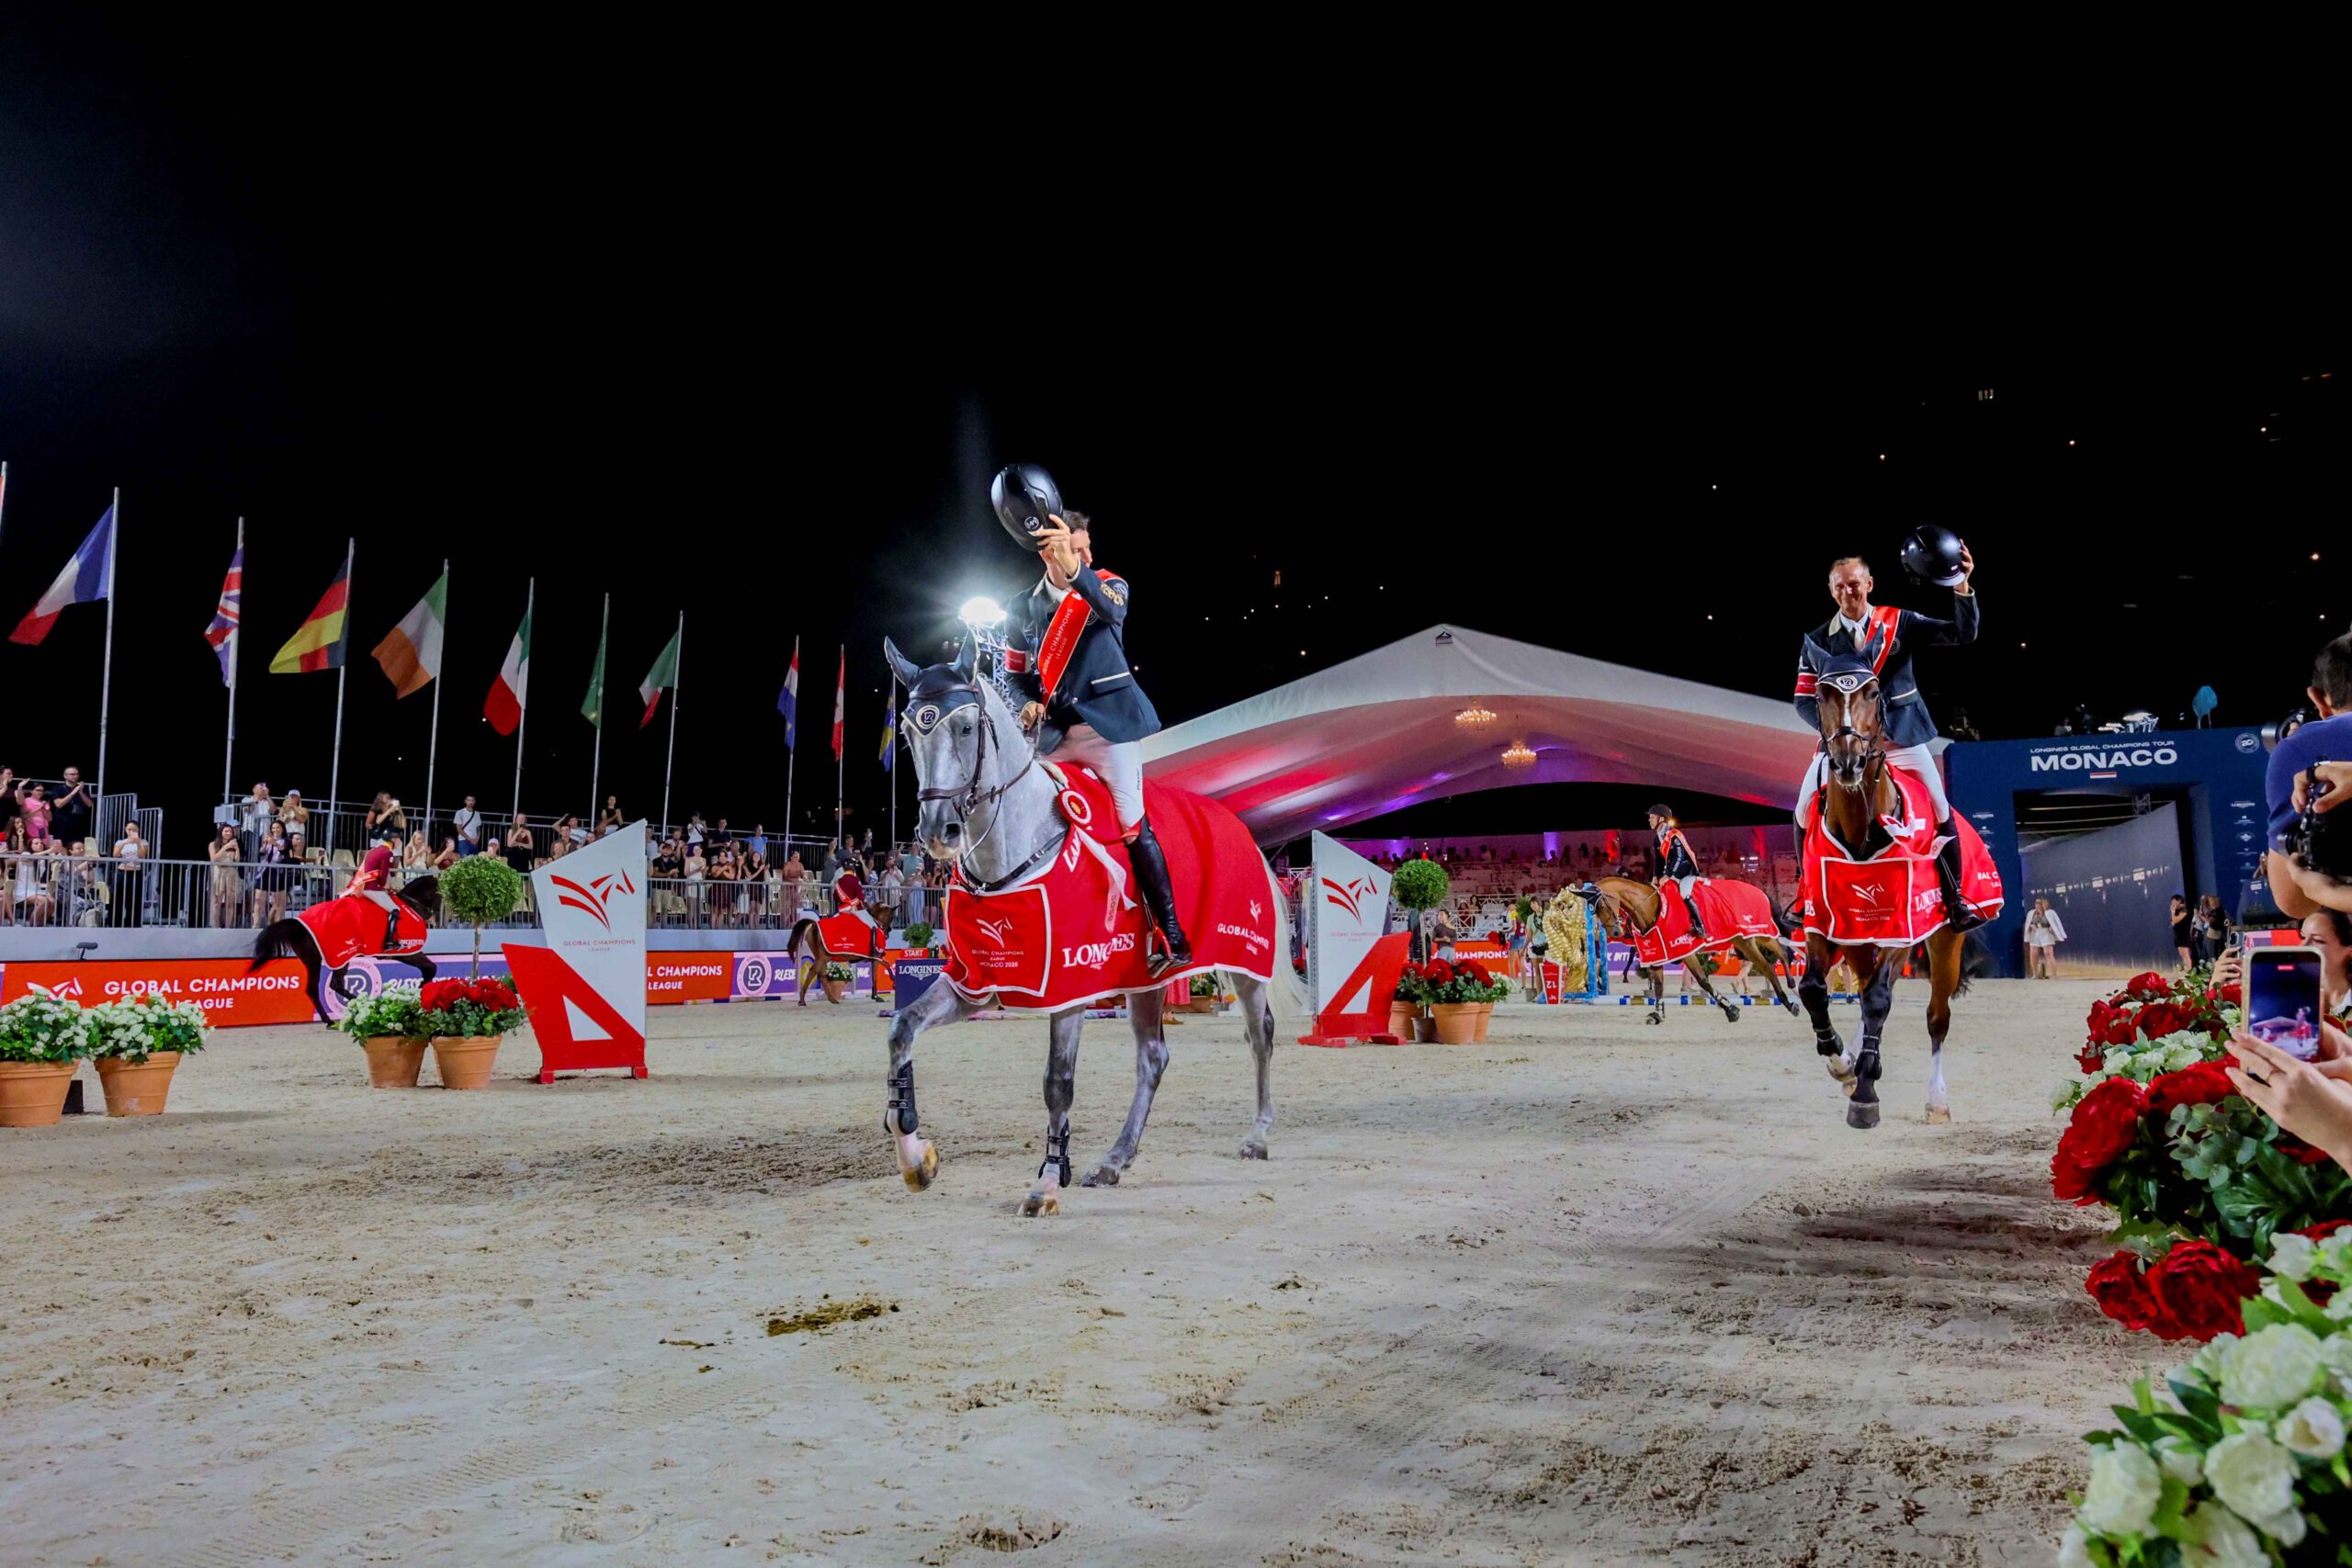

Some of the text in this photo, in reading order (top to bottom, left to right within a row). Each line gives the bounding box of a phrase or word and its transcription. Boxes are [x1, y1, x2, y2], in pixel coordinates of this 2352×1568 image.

[1050, 608, 1073, 651] CHAMPIONS
[2030, 748, 2177, 772] MONACO
[1217, 923, 1250, 938] GLOBAL
[1455, 951, 1508, 960] HAMPIONS
[656, 965, 722, 976] CHAMPIONS
[899, 965, 943, 975] LONGINES
[104, 976, 300, 995] GLOBAL CHAMPIONS
[648, 981, 683, 990] LEAGUE
